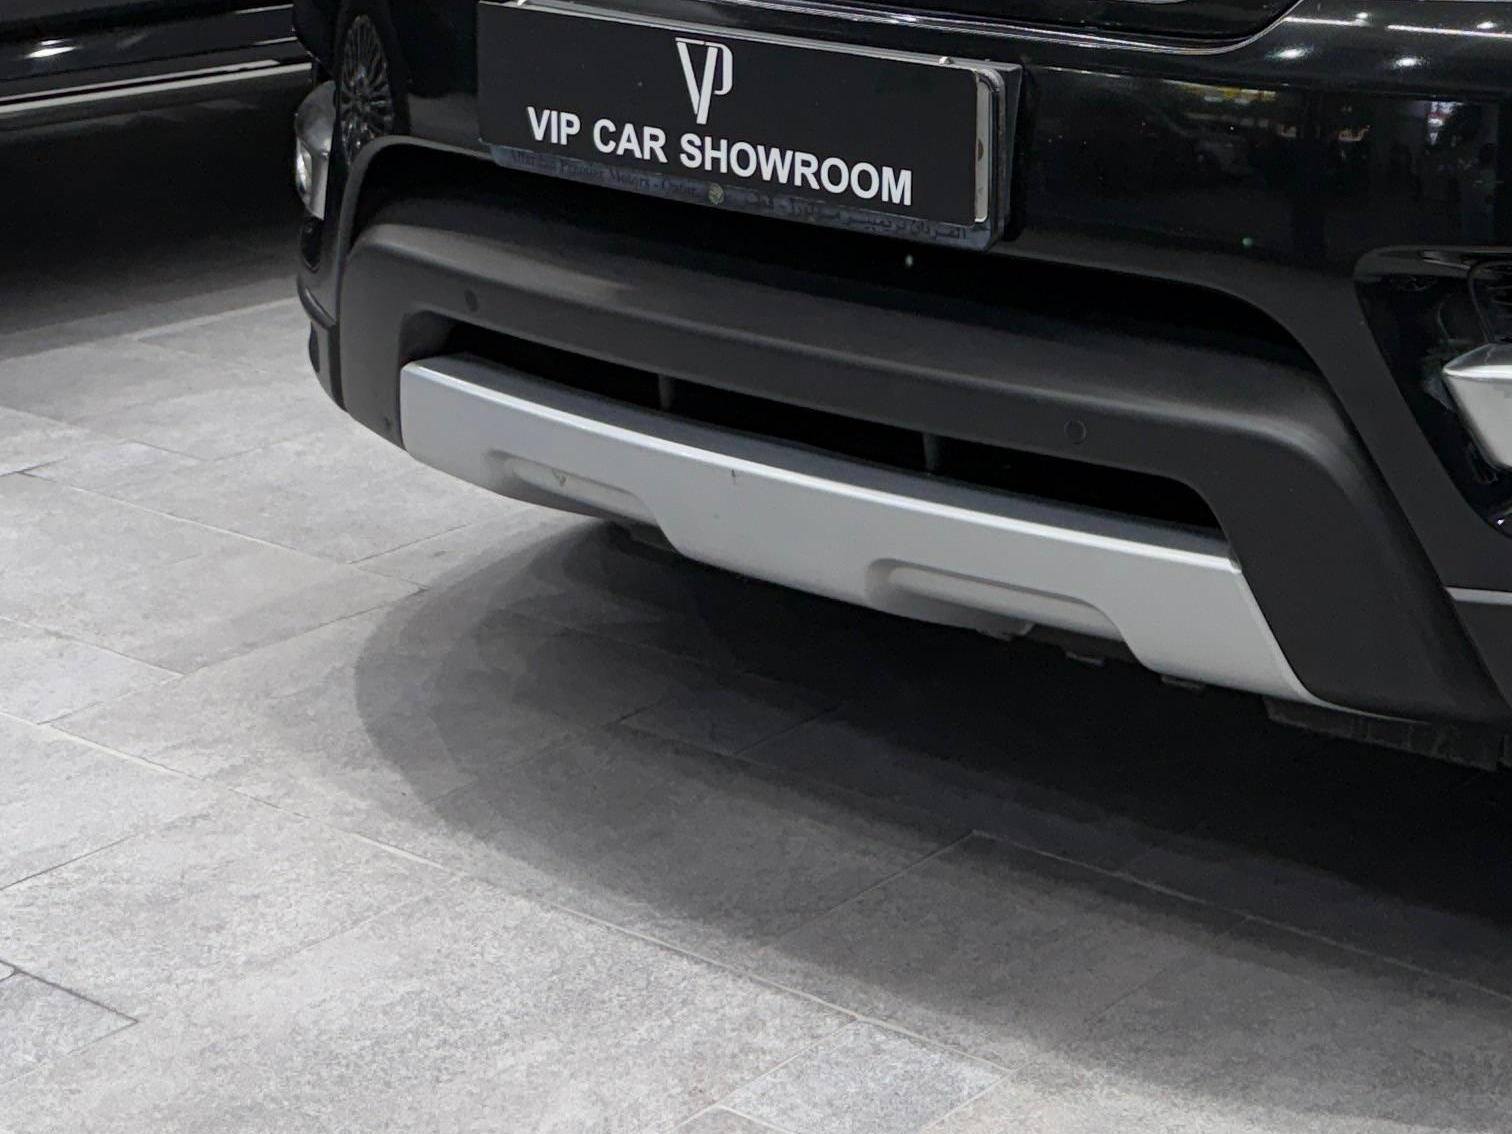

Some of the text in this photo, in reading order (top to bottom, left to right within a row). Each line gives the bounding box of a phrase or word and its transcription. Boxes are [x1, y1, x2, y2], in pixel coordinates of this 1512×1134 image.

[527, 106, 912, 206] VIP CAR SHOWROOM
